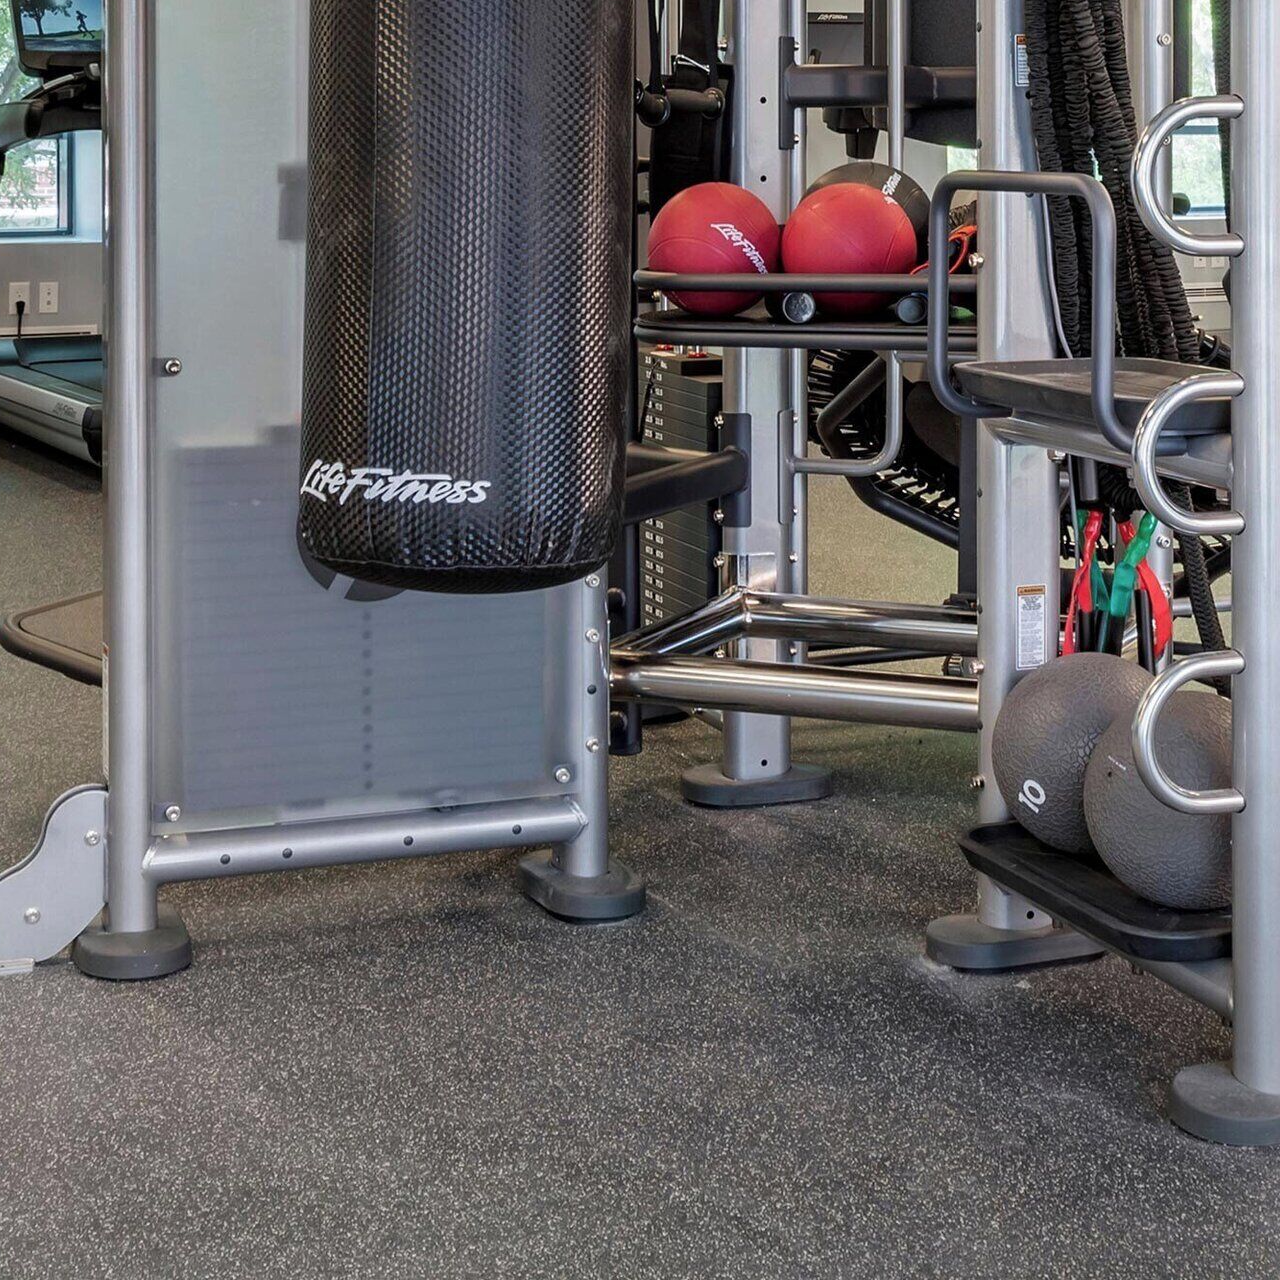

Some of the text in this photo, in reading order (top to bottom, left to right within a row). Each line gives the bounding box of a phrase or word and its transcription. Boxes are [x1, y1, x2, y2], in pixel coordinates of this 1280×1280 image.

[300, 459, 492, 506] Life Fitness
[1018, 779, 1047, 814] 10
